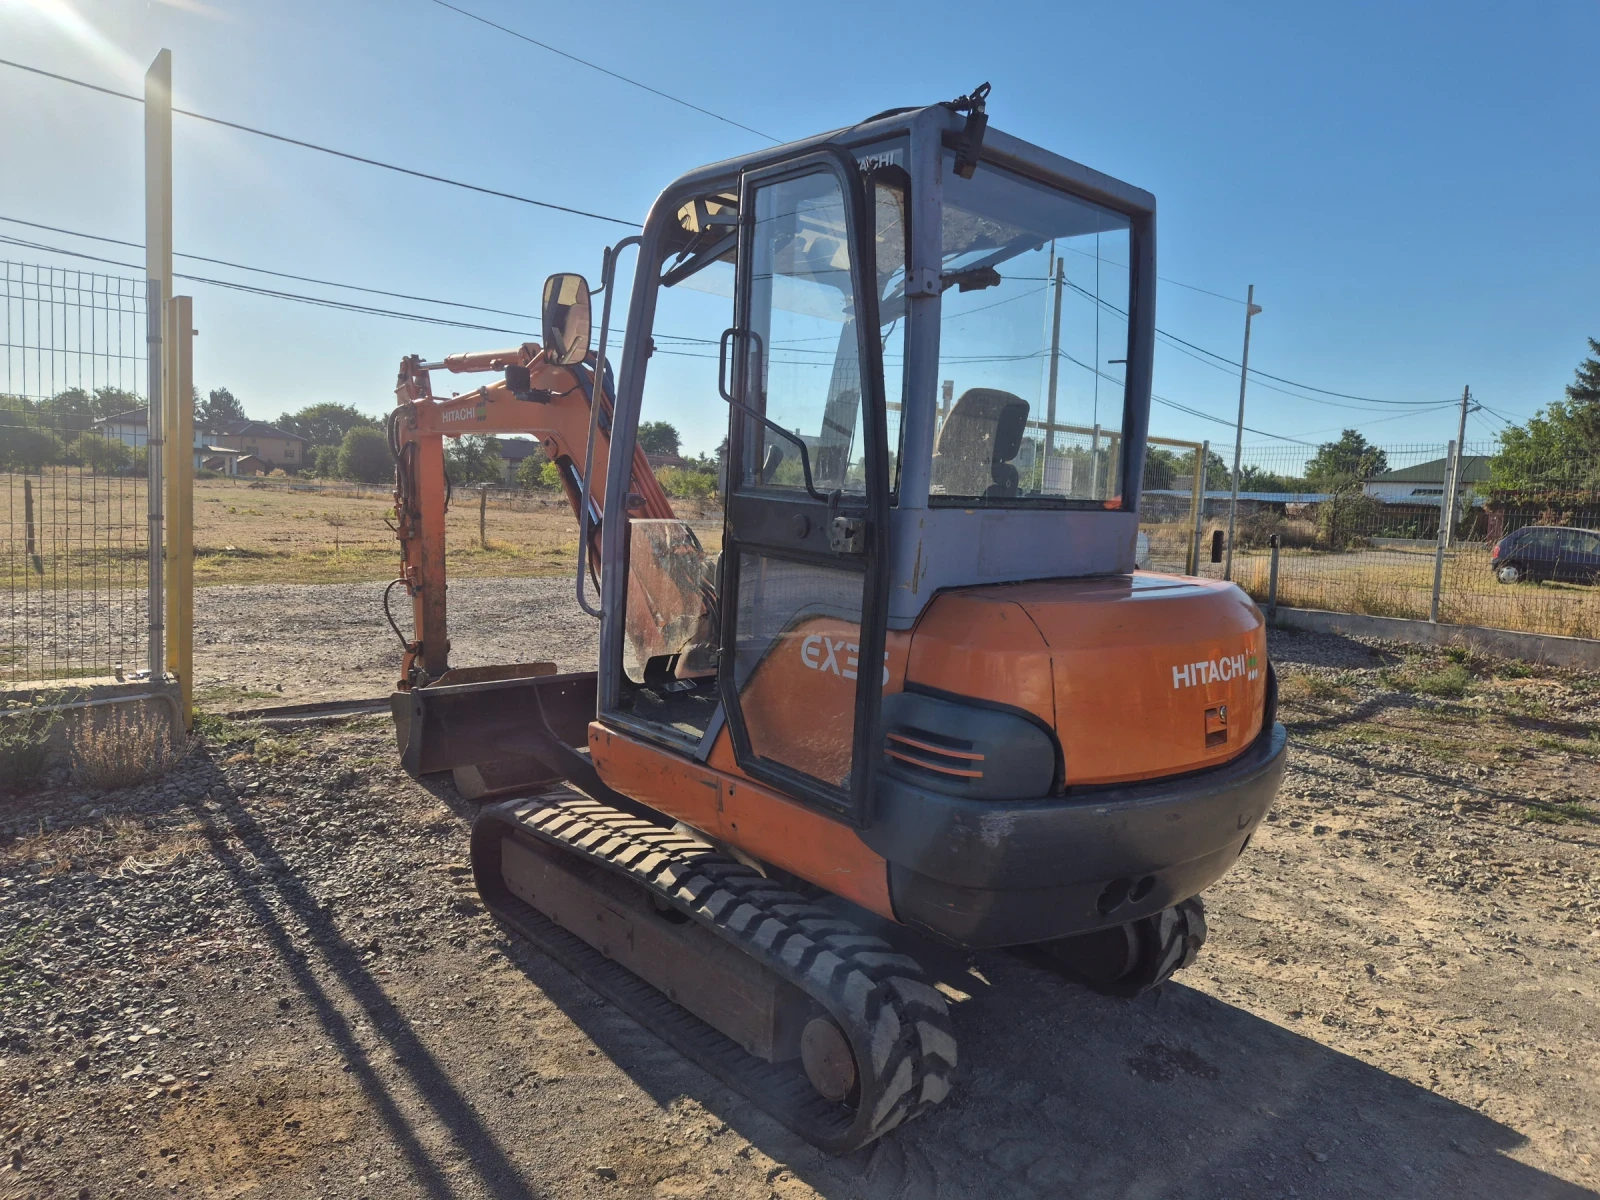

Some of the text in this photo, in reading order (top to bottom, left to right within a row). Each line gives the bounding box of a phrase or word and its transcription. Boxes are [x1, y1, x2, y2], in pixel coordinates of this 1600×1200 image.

[857, 152, 895, 171] ACHI
[442, 407, 475, 423] HITACHI
[801, 634, 890, 687] EX3
[1172, 654, 1246, 689] HITACHI
